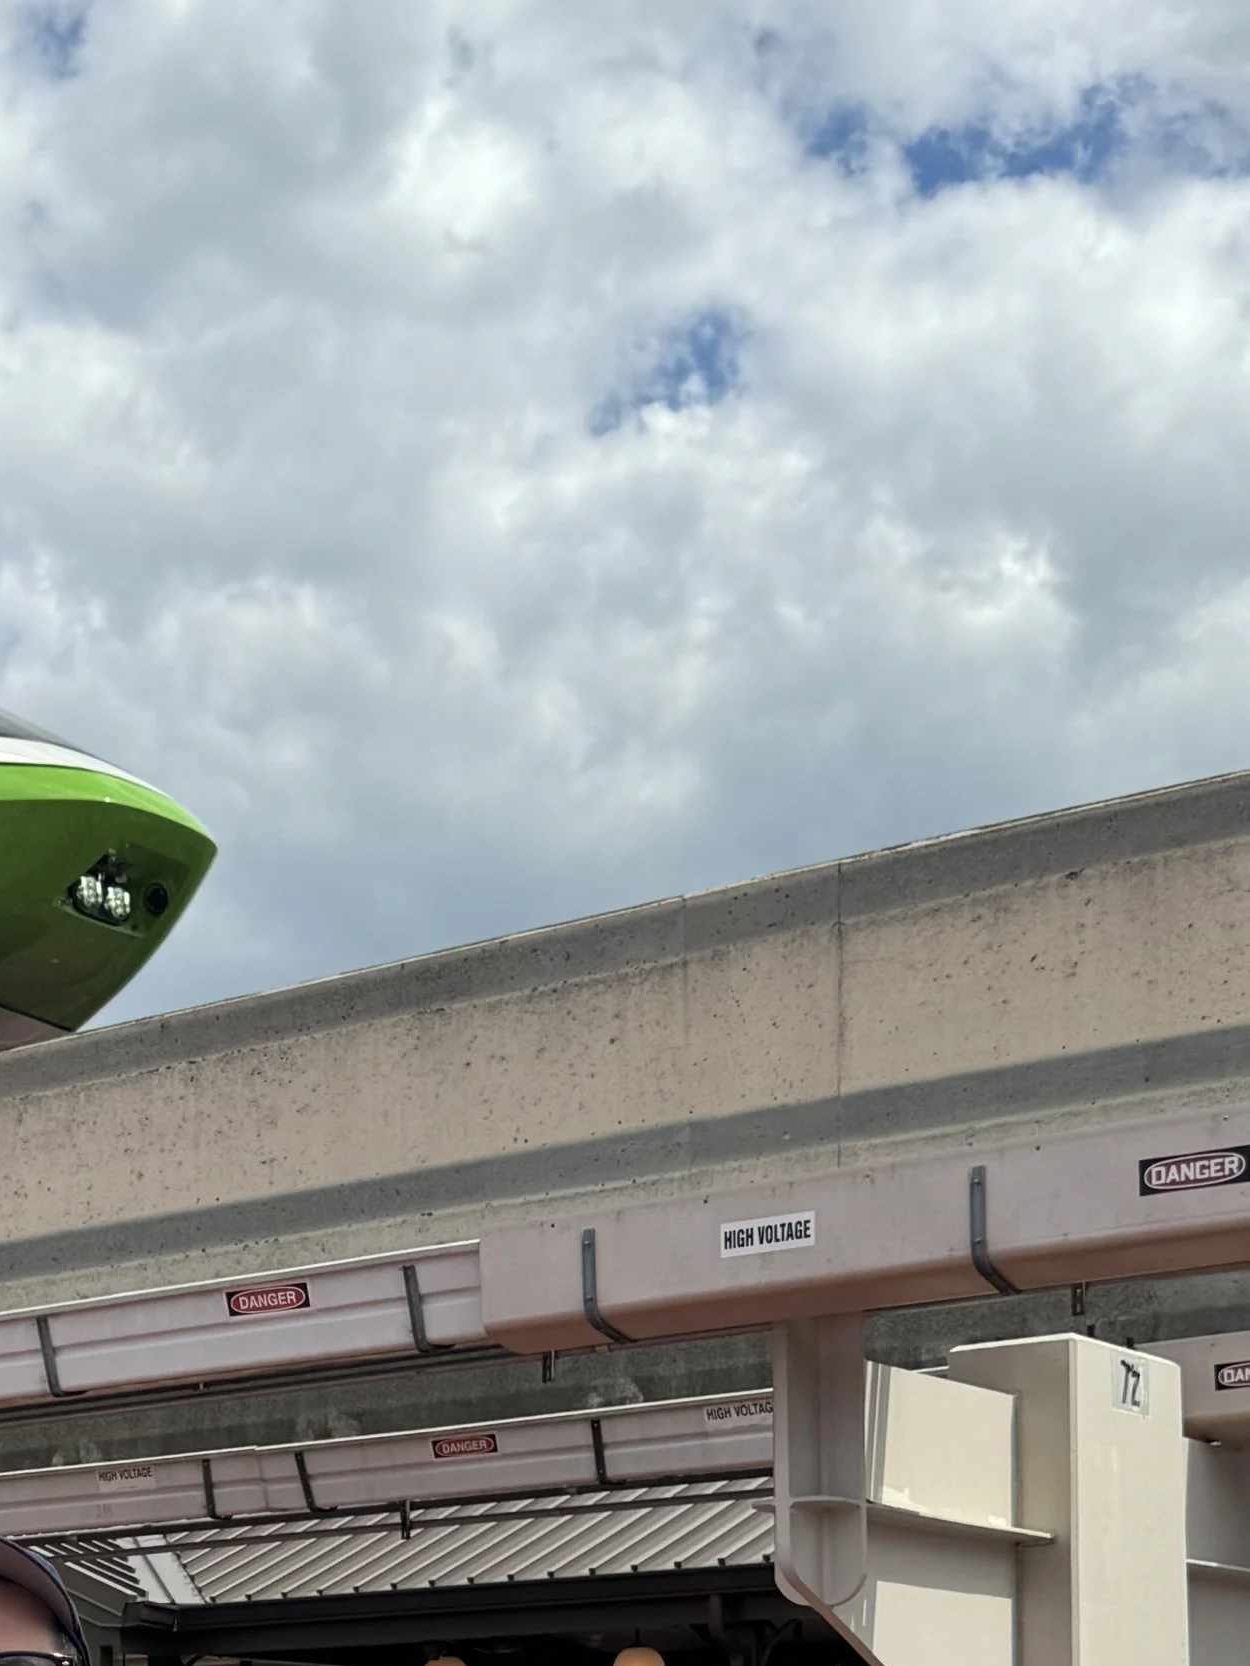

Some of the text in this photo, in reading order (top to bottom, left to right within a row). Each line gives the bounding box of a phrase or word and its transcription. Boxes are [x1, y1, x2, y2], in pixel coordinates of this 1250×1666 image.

[1151, 1156, 1239, 1186] DANGER
[724, 1219, 812, 1250] HIGH VOLTAGE
[239, 1290, 297, 1310] DANGER
[706, 1405, 732, 1421] HIGH
[441, 1439, 488, 1454] DANGER
[98, 1466, 153, 1482] HIGH VOLTAGE
